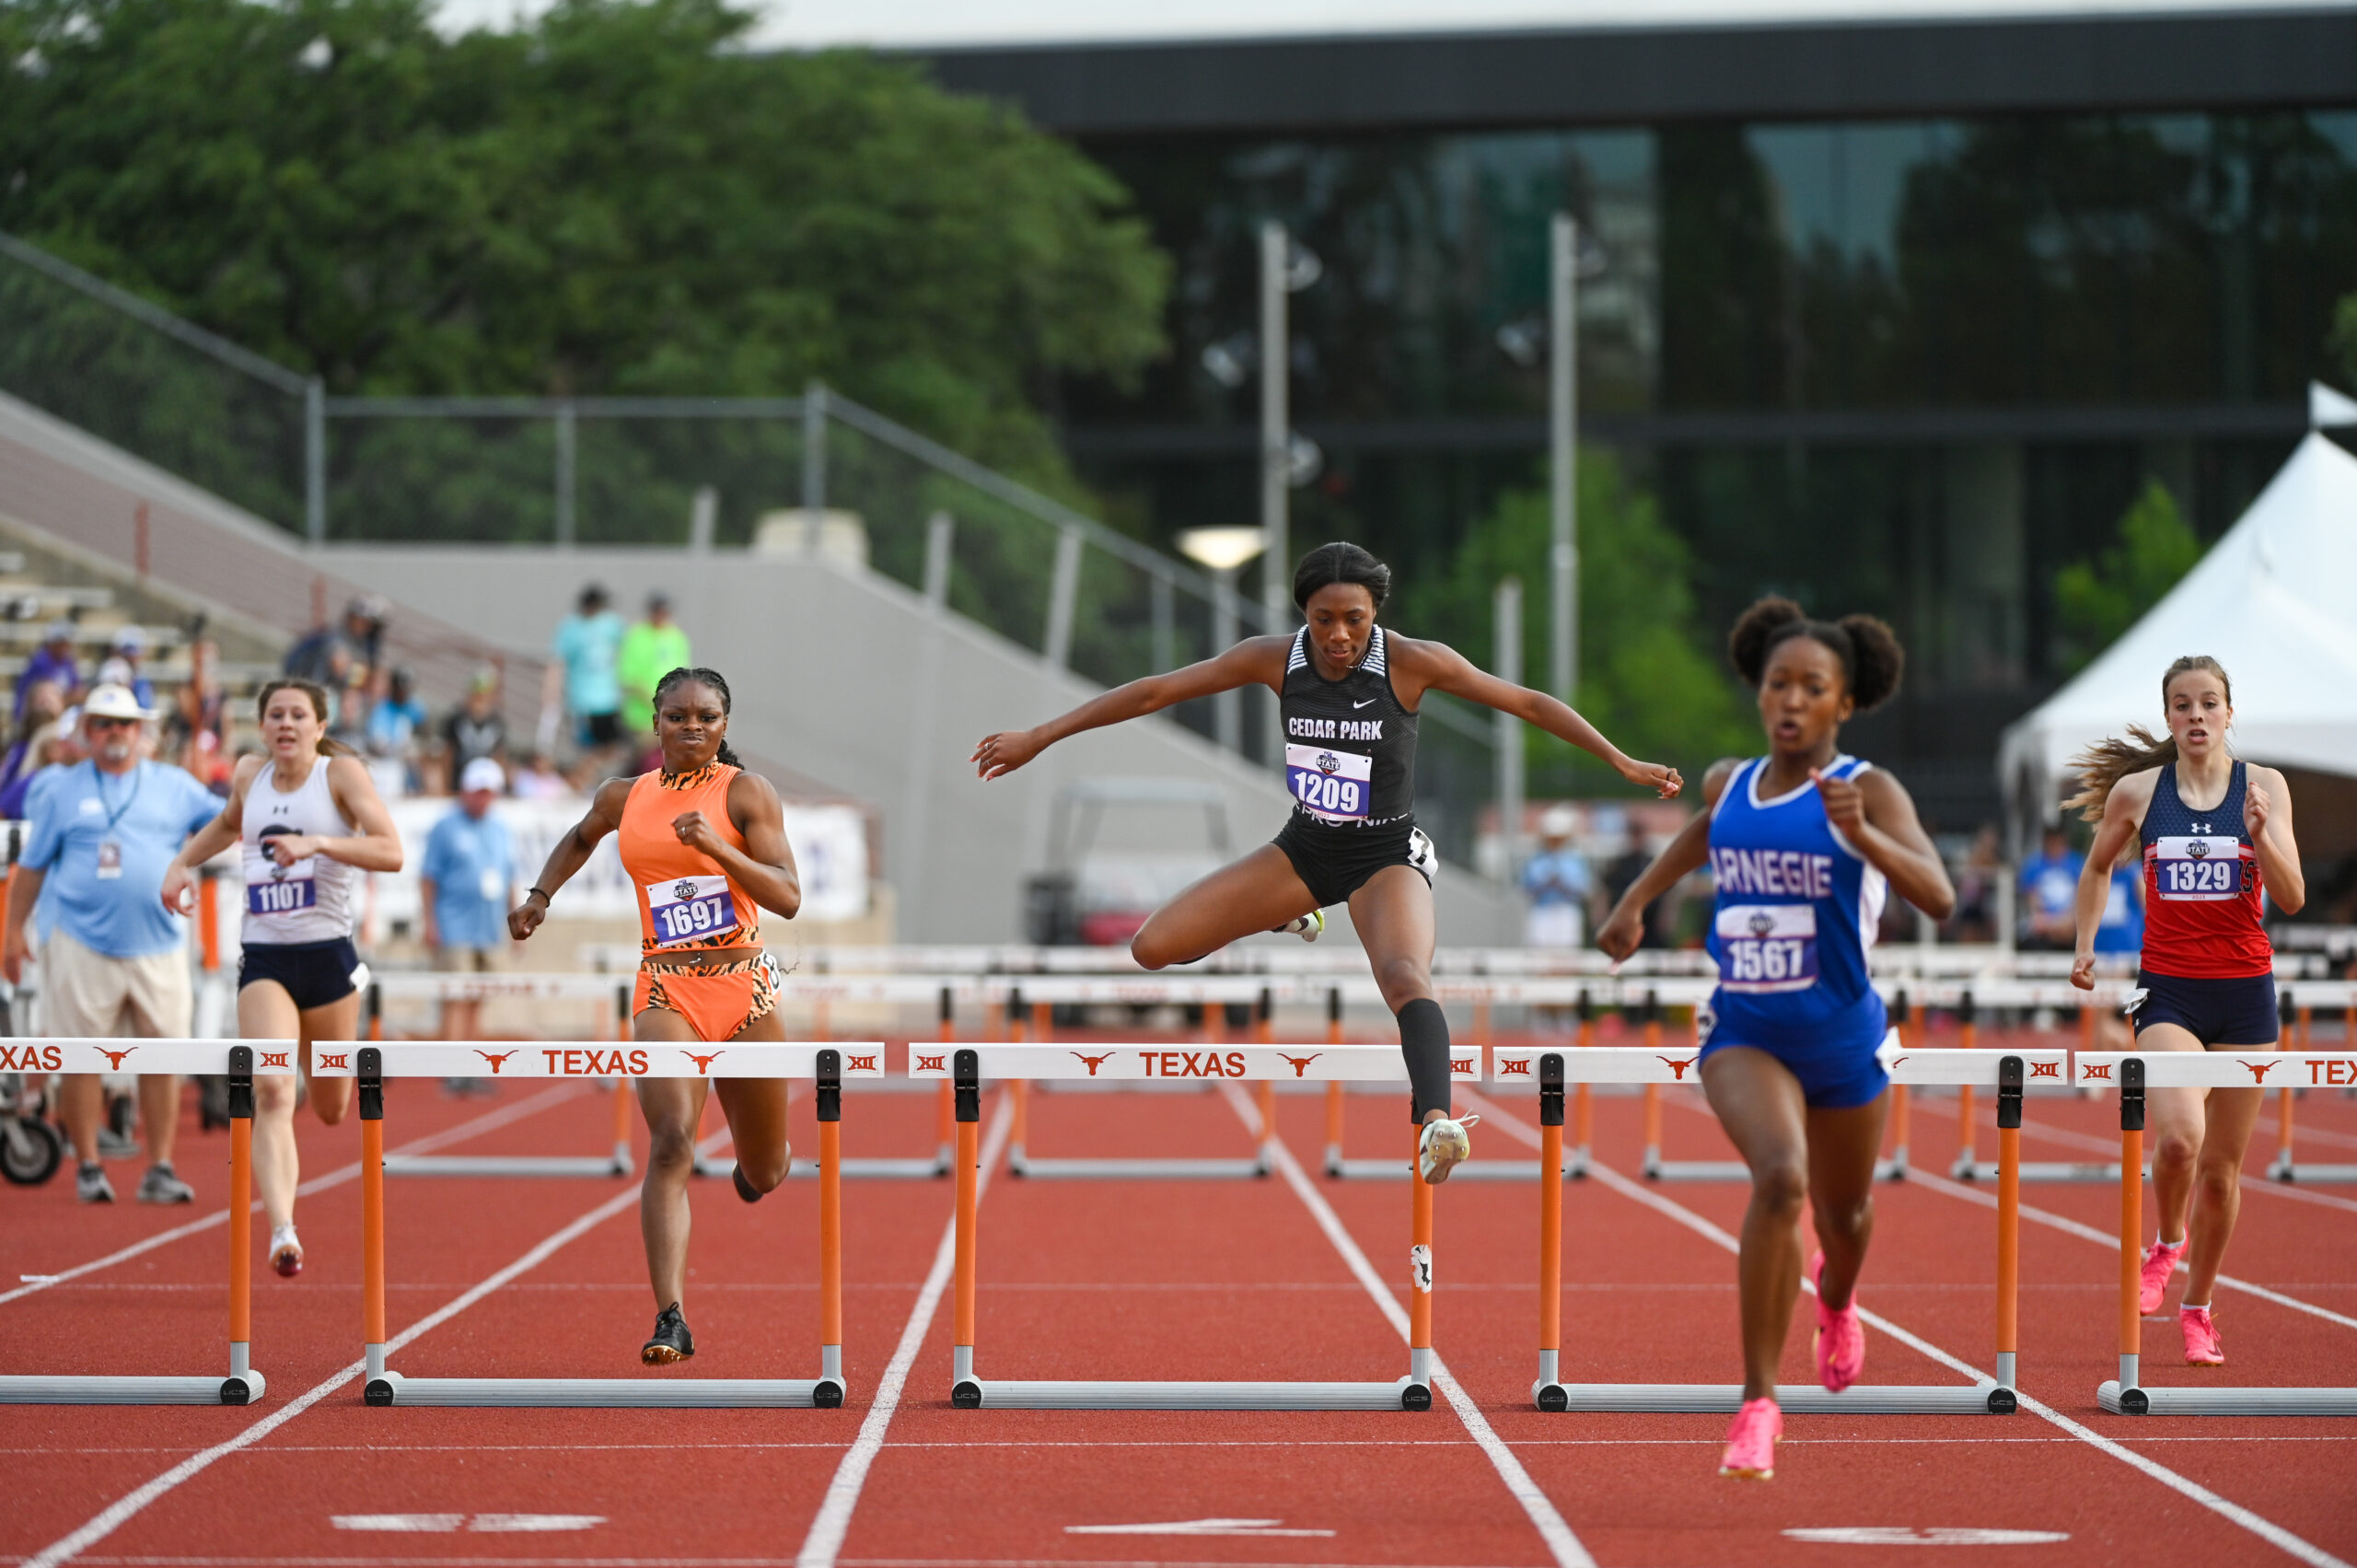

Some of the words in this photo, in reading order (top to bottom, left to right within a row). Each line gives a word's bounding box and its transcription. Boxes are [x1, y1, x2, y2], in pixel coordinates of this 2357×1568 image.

[1289, 717, 1335, 738] CEDAR
[1340, 719, 1383, 740] PARK
[1295, 772, 1360, 812] 1209
[1318, 810, 1330, 819] 2023
[2166, 862, 2231, 890] 1329
[259, 881, 305, 912] 1107
[661, 897, 722, 937] 1697
[1727, 940, 1804, 981] 1567
[542, 1050, 649, 1075] TEXAS
[1139, 1052, 1246, 1077] TEXAS
